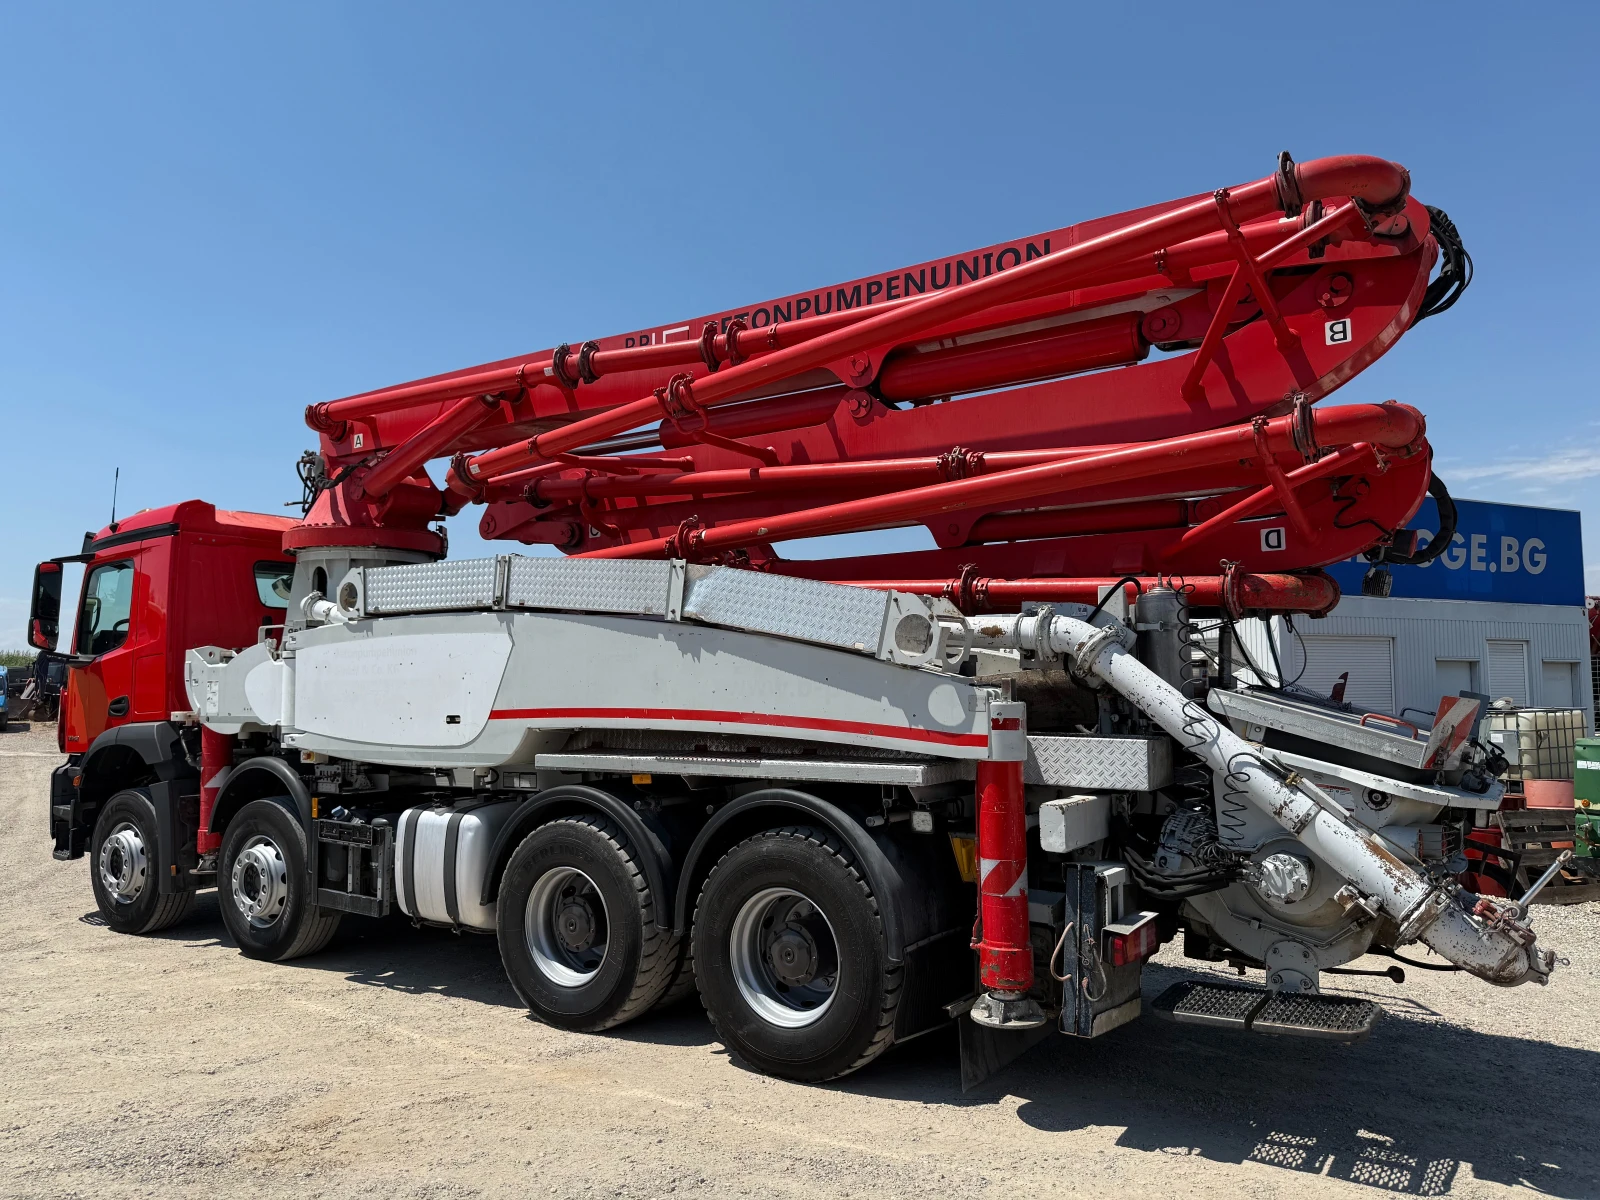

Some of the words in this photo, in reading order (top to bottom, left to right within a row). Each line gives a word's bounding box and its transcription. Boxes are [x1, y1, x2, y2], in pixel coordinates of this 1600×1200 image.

[721, 239, 1050, 334] ETONPUMPENUNION
[1329, 320, 1348, 342] B
[354, 434, 362, 447] A
[1264, 528, 1282, 549] D
